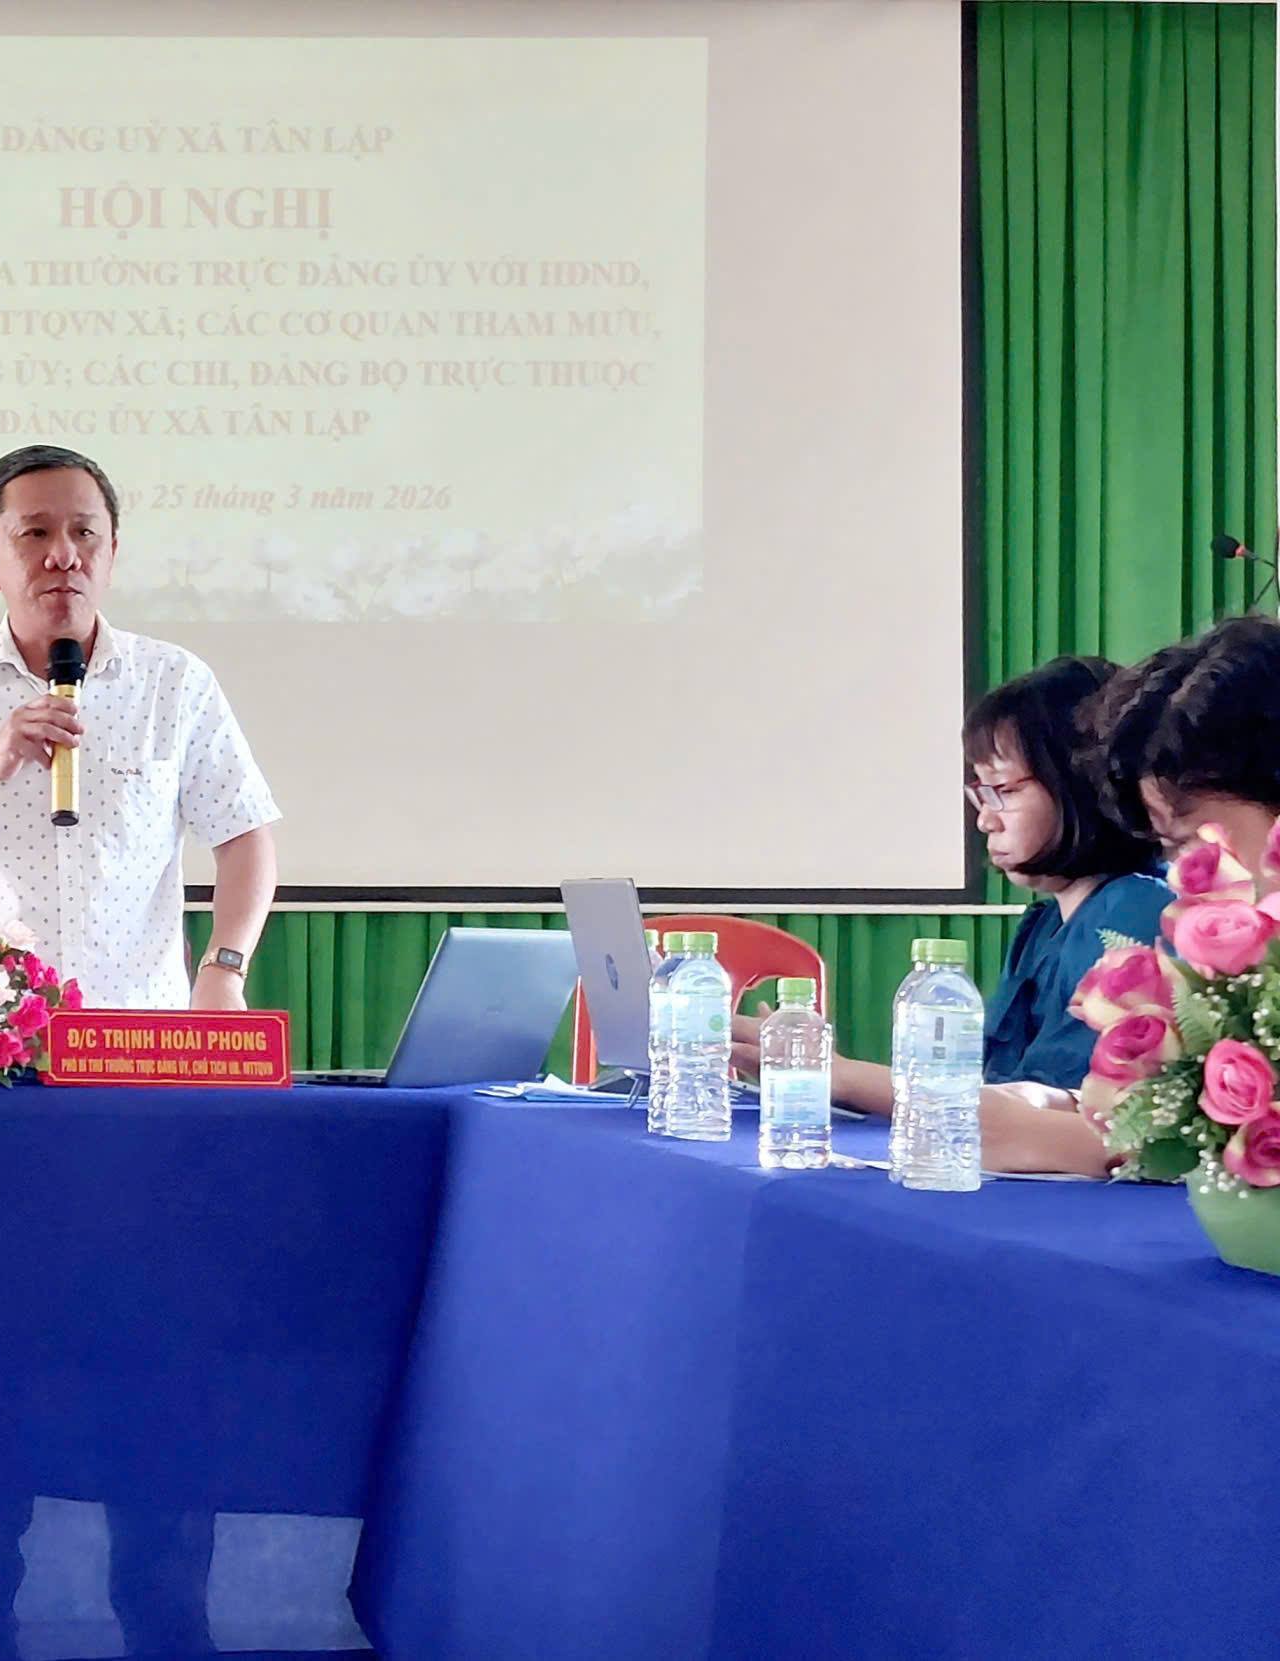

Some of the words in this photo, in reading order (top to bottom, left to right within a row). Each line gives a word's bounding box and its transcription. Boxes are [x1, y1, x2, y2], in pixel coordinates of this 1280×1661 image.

[0, 112, 106, 153] ĐẢNG
[176, 122, 227, 153] XÃ
[238, 118, 313, 153] TÂN
[57, 179, 168, 240] HỘI
[184, 186, 335, 240] NGHỊ
[23, 252, 179, 287] THƯỜNG
[190, 258, 289, 295] TRỰC
[297, 252, 398, 288] ĐẢNG
[464, 254, 529, 288] VỚI
[538, 259, 651, 292] HĐND,
[126, 305, 186, 340] XÃ;
[196, 304, 272, 338] CÁC
[278, 308, 333, 338] CƠ
[339, 310, 440, 342] QUAN
[449, 310, 555, 337] THAM
[567, 308, 663, 340] MƯU,
[82, 352, 158, 386] CÁC
[167, 359, 239, 390] CHI,
[248, 353, 349, 388] ĐẢNG
[359, 355, 408, 392] BỘ
[415, 359, 519, 393] TRỰC
[525, 356, 654, 392] THUỘC
[163, 405, 212, 436] XÃ
[223, 402, 293, 436] TÂN
[150, 483, 184, 510] 25
[192, 482, 274, 514] tháng
[284, 484, 300, 511] 3
[310, 486, 374, 511] năm
[383, 483, 452, 511] 2026
[67, 1028, 97, 1049] Đ/C
[102, 1029, 155, 1053] TRỊNH
[160, 1026, 202, 1050] HOÀI
[207, 1031, 267, 1051] PHONG
